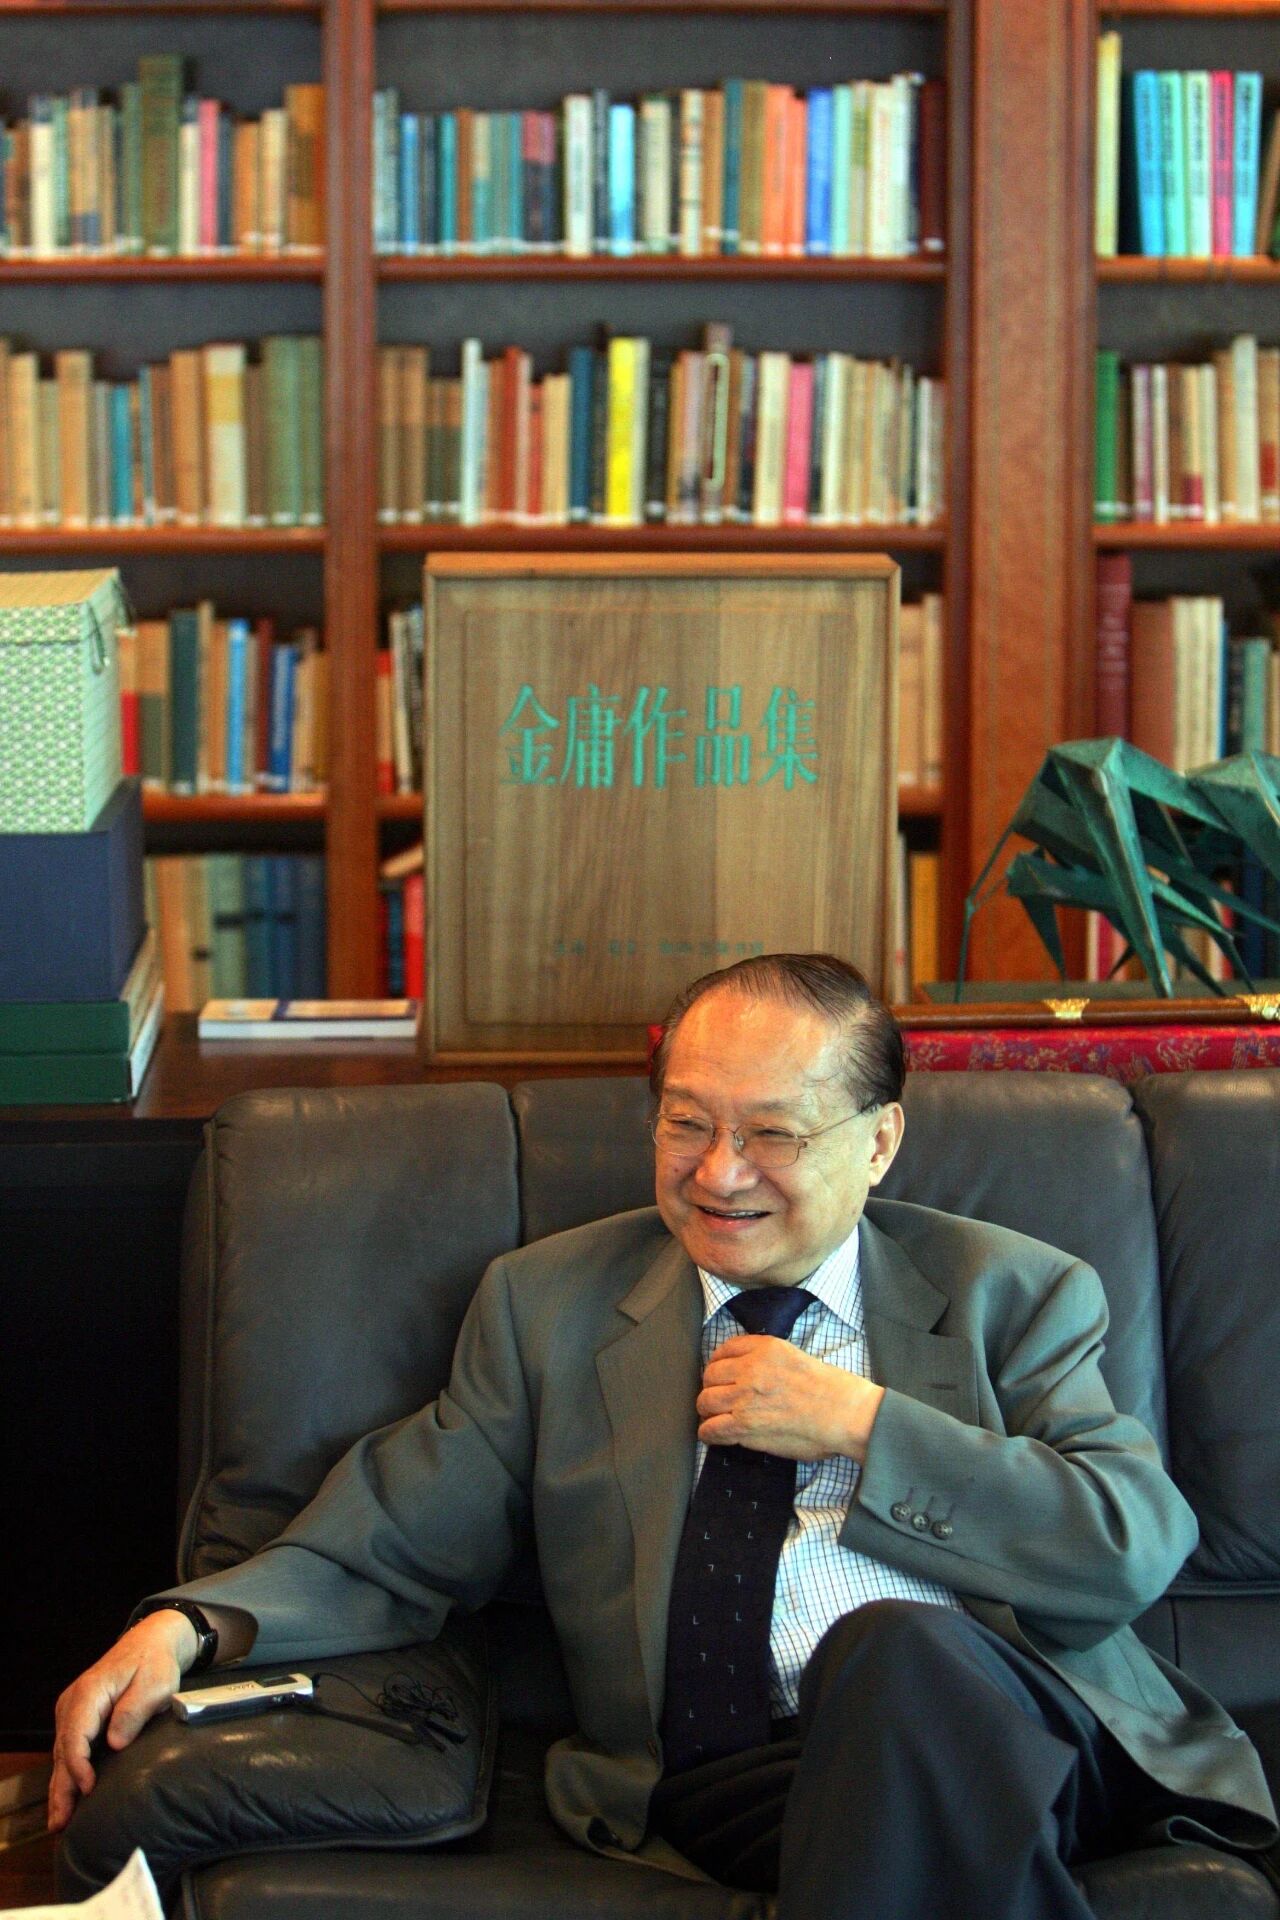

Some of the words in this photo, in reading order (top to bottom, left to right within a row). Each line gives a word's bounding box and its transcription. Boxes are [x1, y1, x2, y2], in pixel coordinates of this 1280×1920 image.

[500, 684, 818, 790] 金庸作品集
